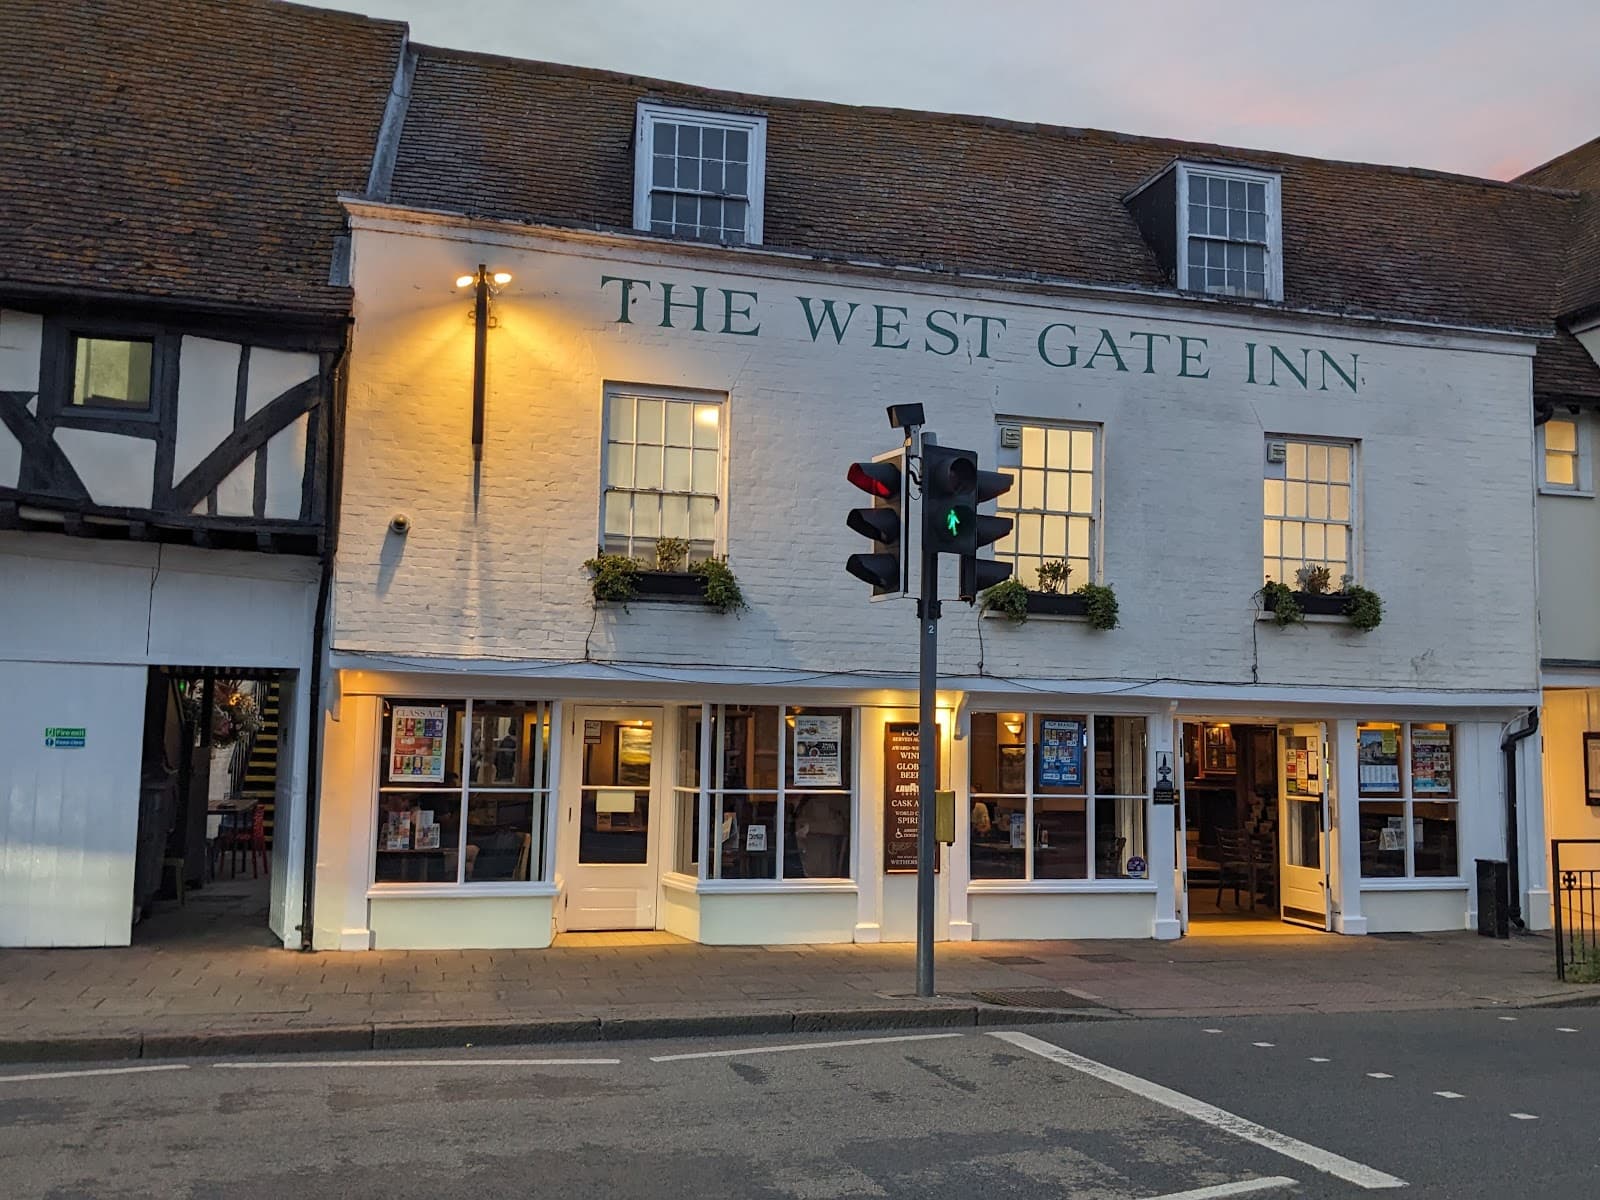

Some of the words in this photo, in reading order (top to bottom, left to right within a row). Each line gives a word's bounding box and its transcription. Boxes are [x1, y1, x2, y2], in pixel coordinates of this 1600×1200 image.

[601, 275, 761, 337] THE
[796, 296, 1007, 359] WEST
[1038, 323, 1210, 379] GATE
[1245, 342, 1360, 393] INN
[928, 625, 935, 634] 2
